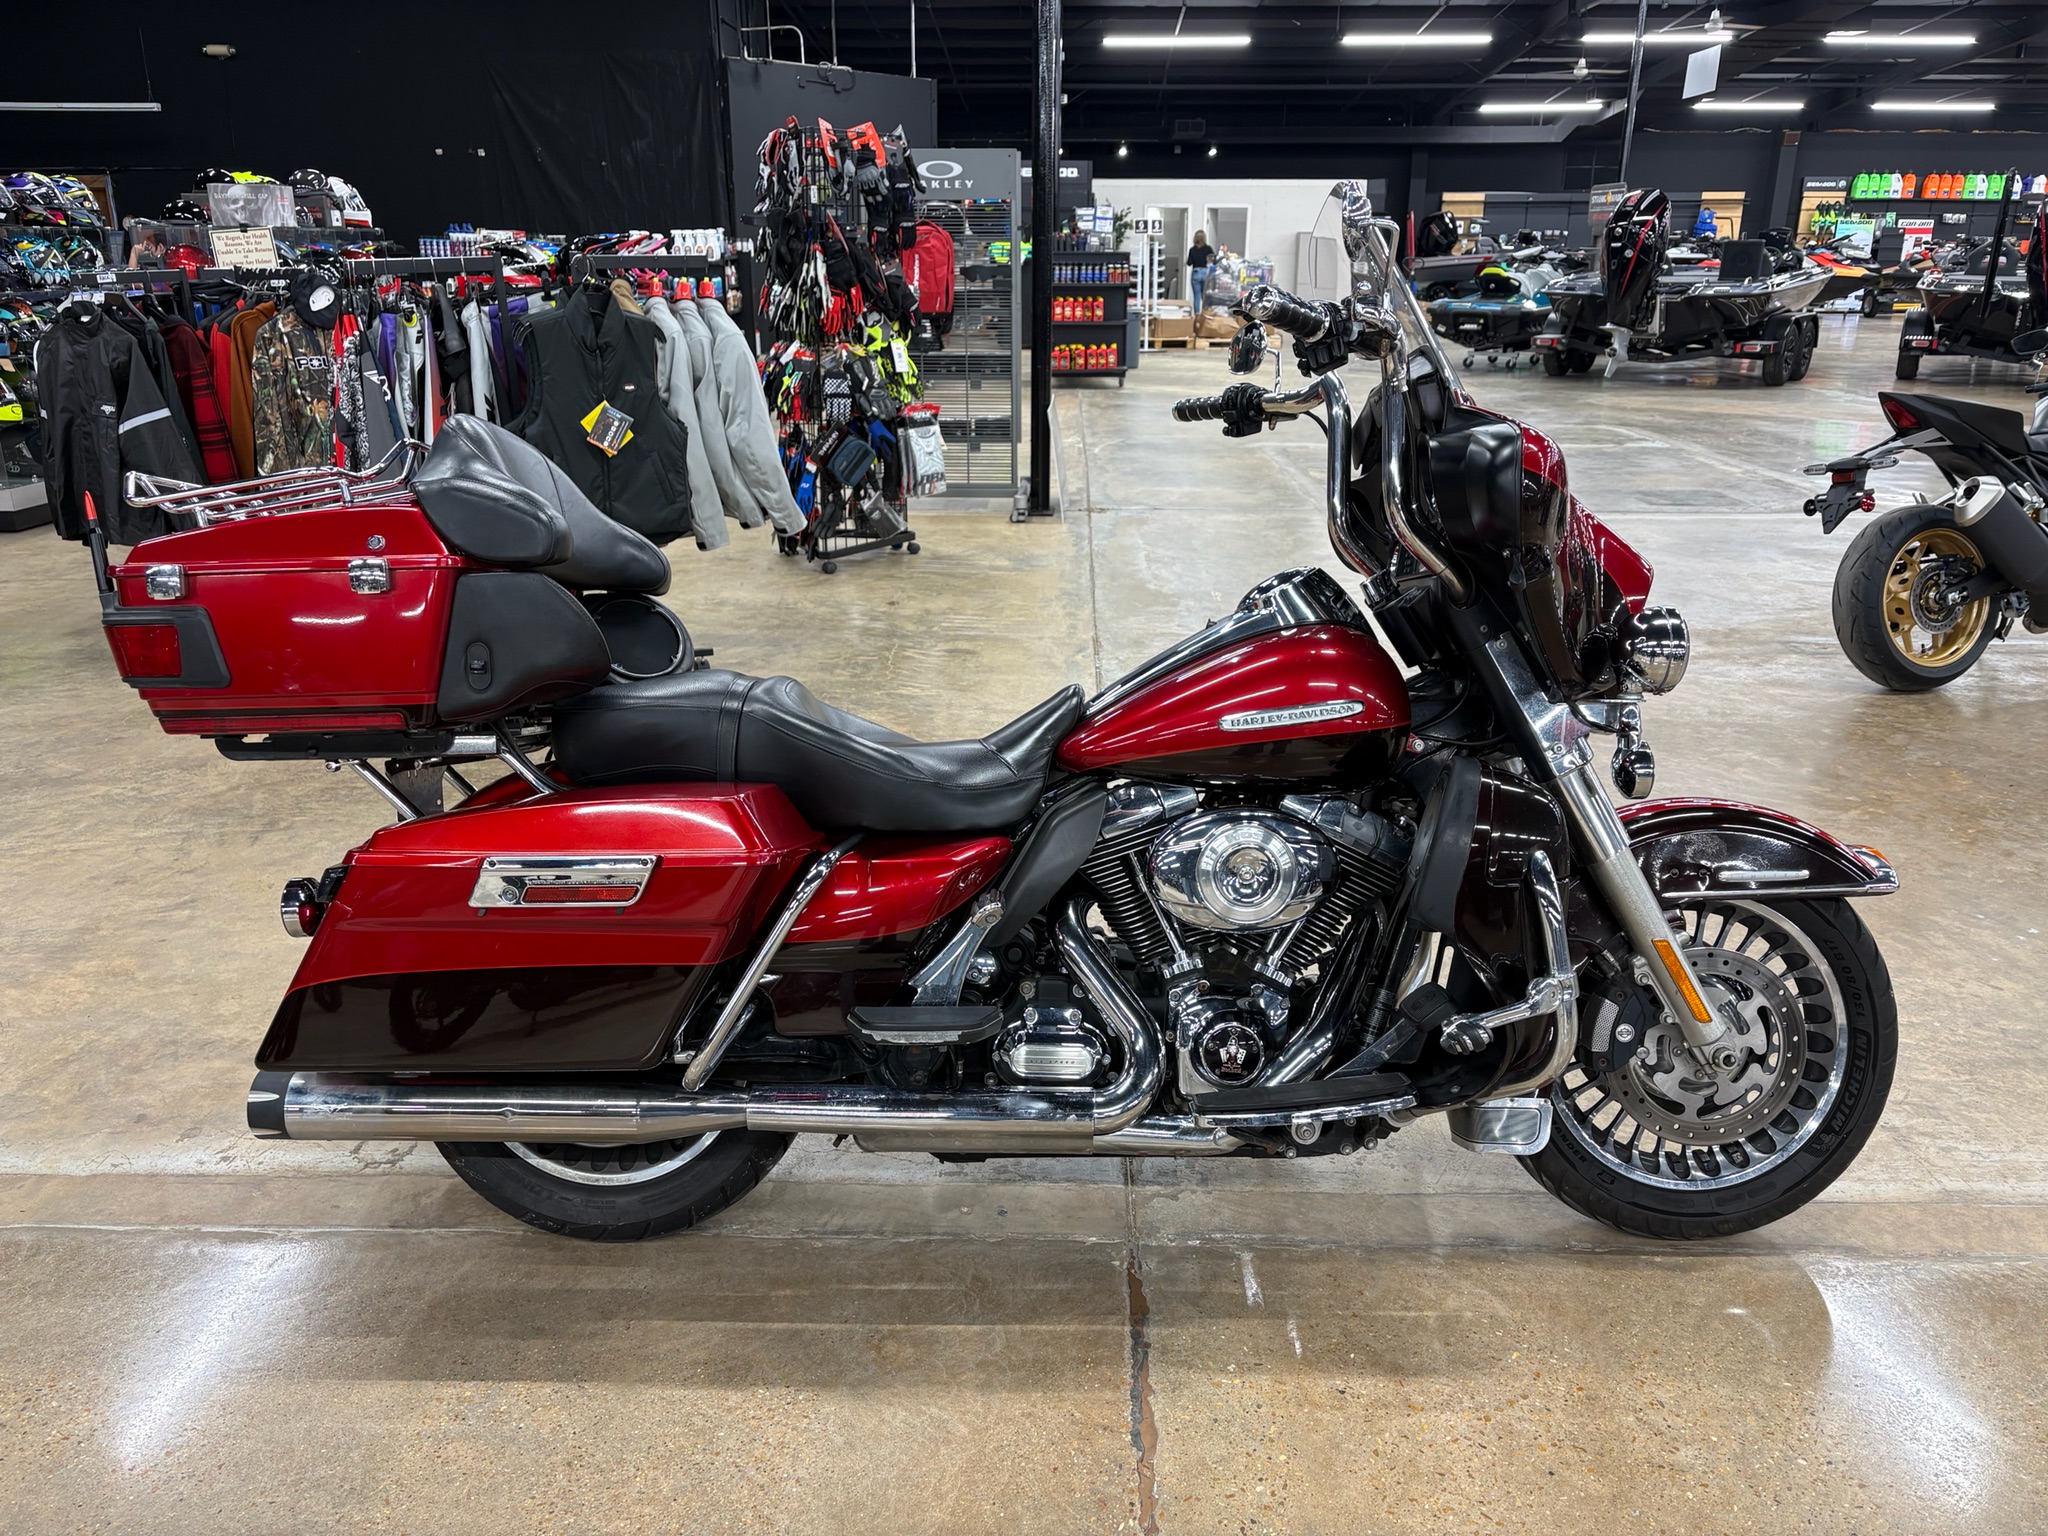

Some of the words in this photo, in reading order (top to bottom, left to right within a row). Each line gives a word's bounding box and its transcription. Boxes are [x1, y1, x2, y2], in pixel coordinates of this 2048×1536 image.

[912, 179, 974, 189] AKLEY
[1230, 704, 1356, 727] HARLEY-DAVIDSON
[1821, 937, 1847, 963] B17
[1839, 965, 1867, 1019] 130/80
[1831, 1030, 1871, 1134] MICHELIN
